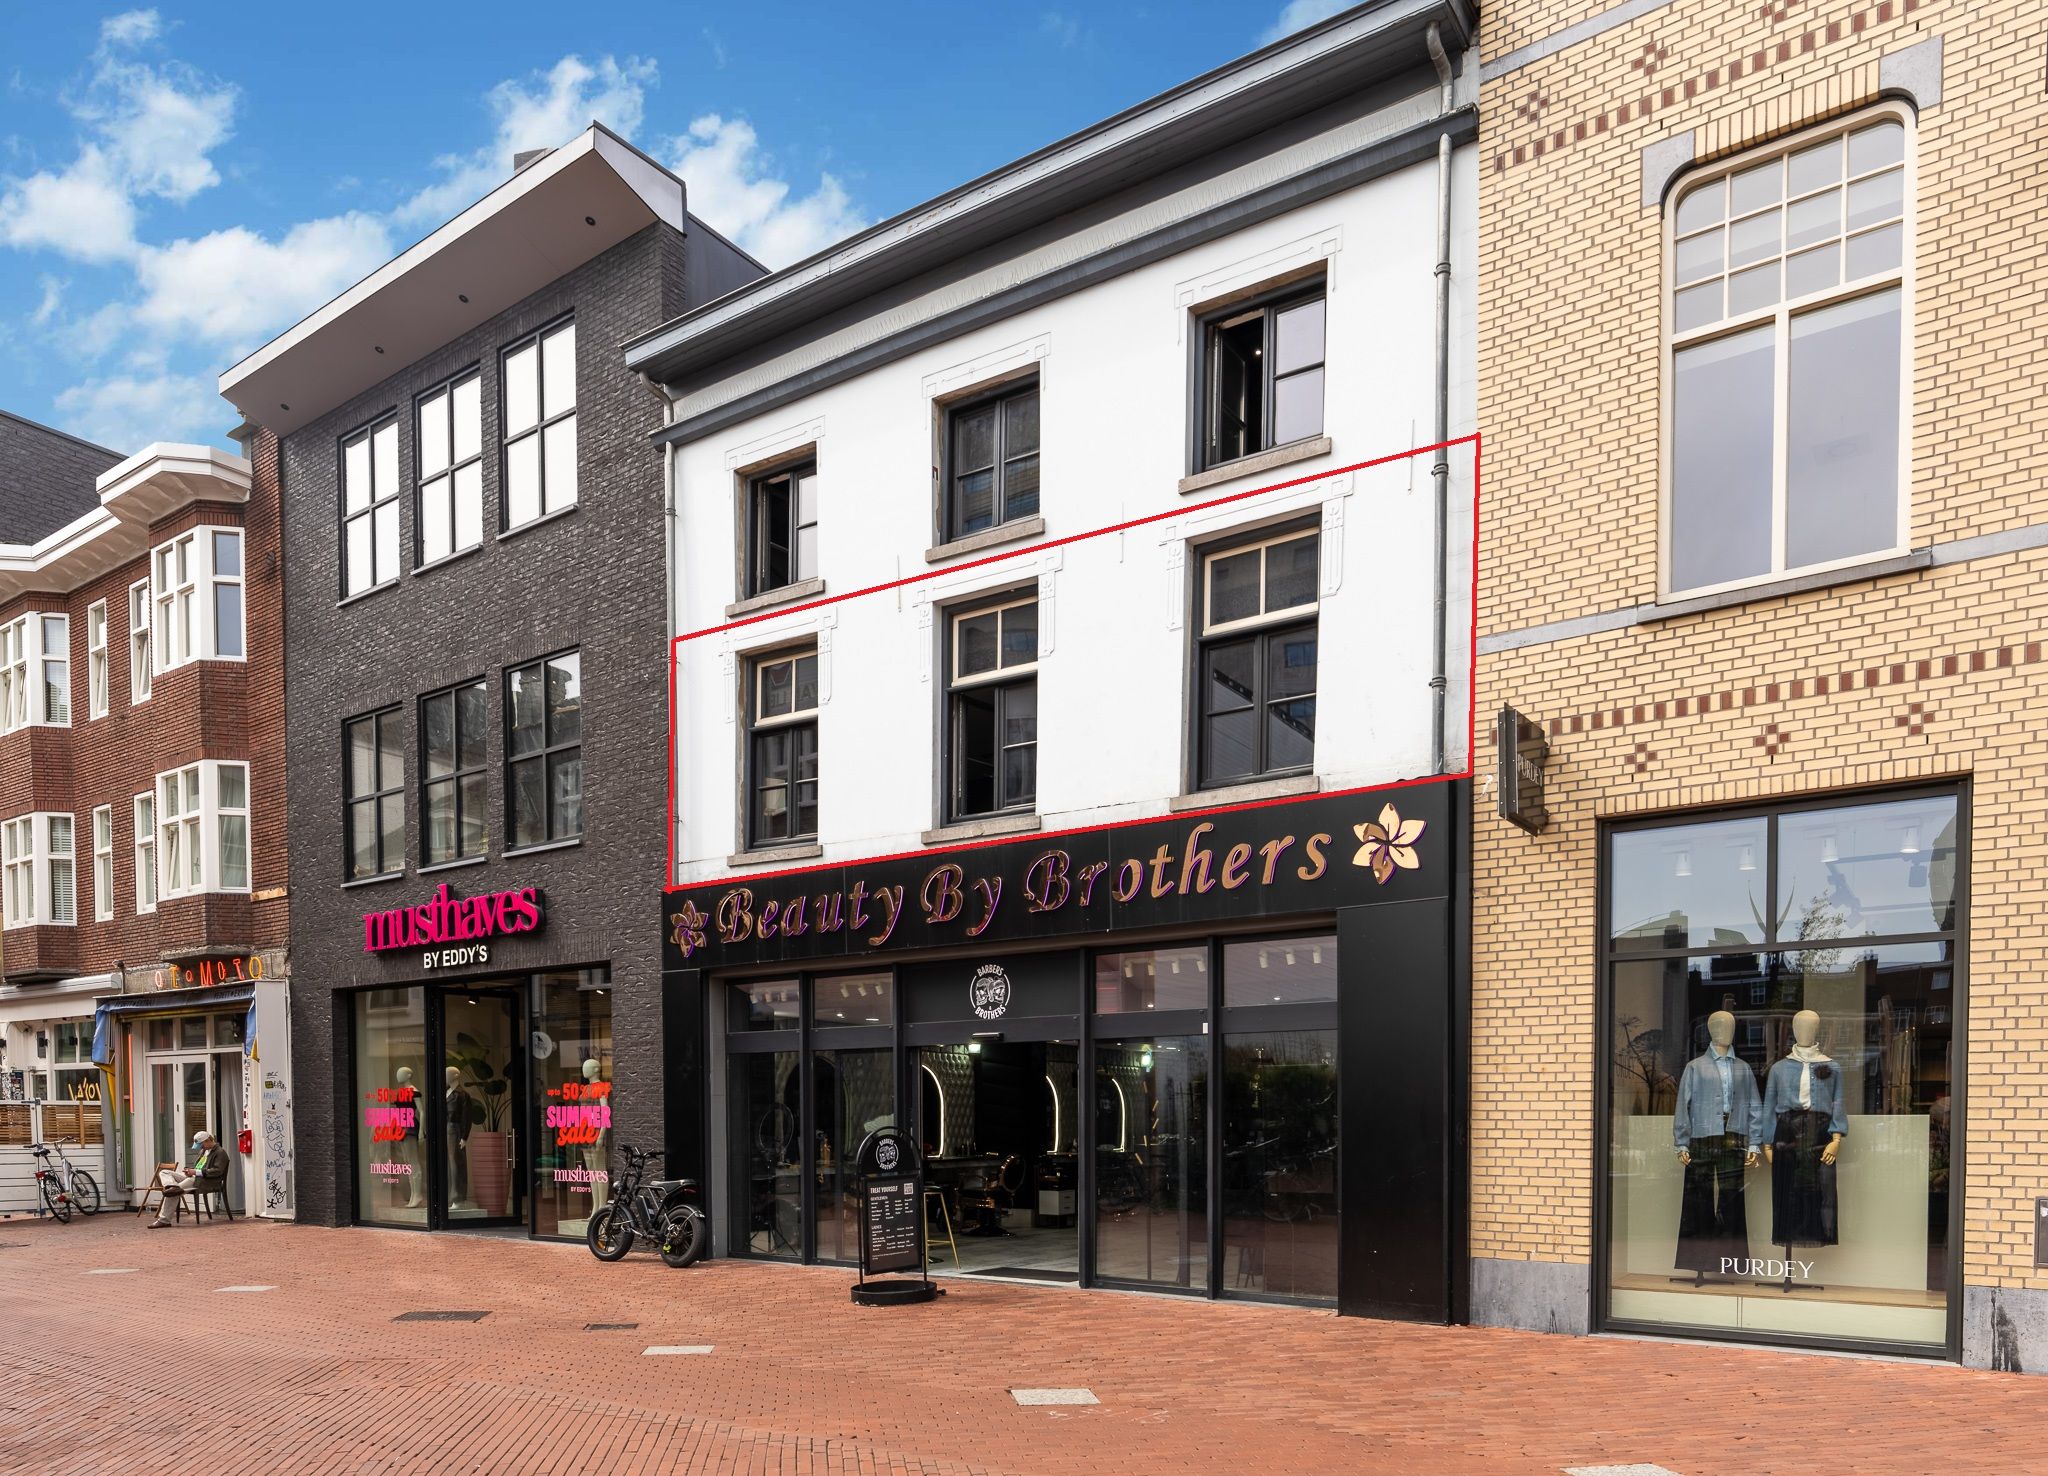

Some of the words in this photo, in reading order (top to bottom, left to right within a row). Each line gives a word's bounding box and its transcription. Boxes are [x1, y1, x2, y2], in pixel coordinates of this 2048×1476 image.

[1517, 753, 1544, 788] PURDEY
[715, 888, 904, 947] Beauty
[920, 863, 1003, 938] By
[1023, 822, 1333, 914] Brothers
[363, 883, 541, 952] musthaves
[423, 951, 440, 969] BY
[442, 944, 488, 967] EDDY'S
[976, 964, 1004, 977] BARBERS
[974, 1004, 1006, 1020] BROTHERS
[397, 1087, 414, 1103] OFF
[590, 1082, 612, 1100] OFF
[364, 1107, 415, 1128] SUMMER
[546, 1105, 612, 1129] SUMMER
[373, 1117, 406, 1143] sale
[556, 1117, 601, 1146] sale
[370, 1160, 412, 1176] musthaves
[553, 1164, 609, 1184] musthaves
[1720, 1256, 1815, 1279] PURDEY
